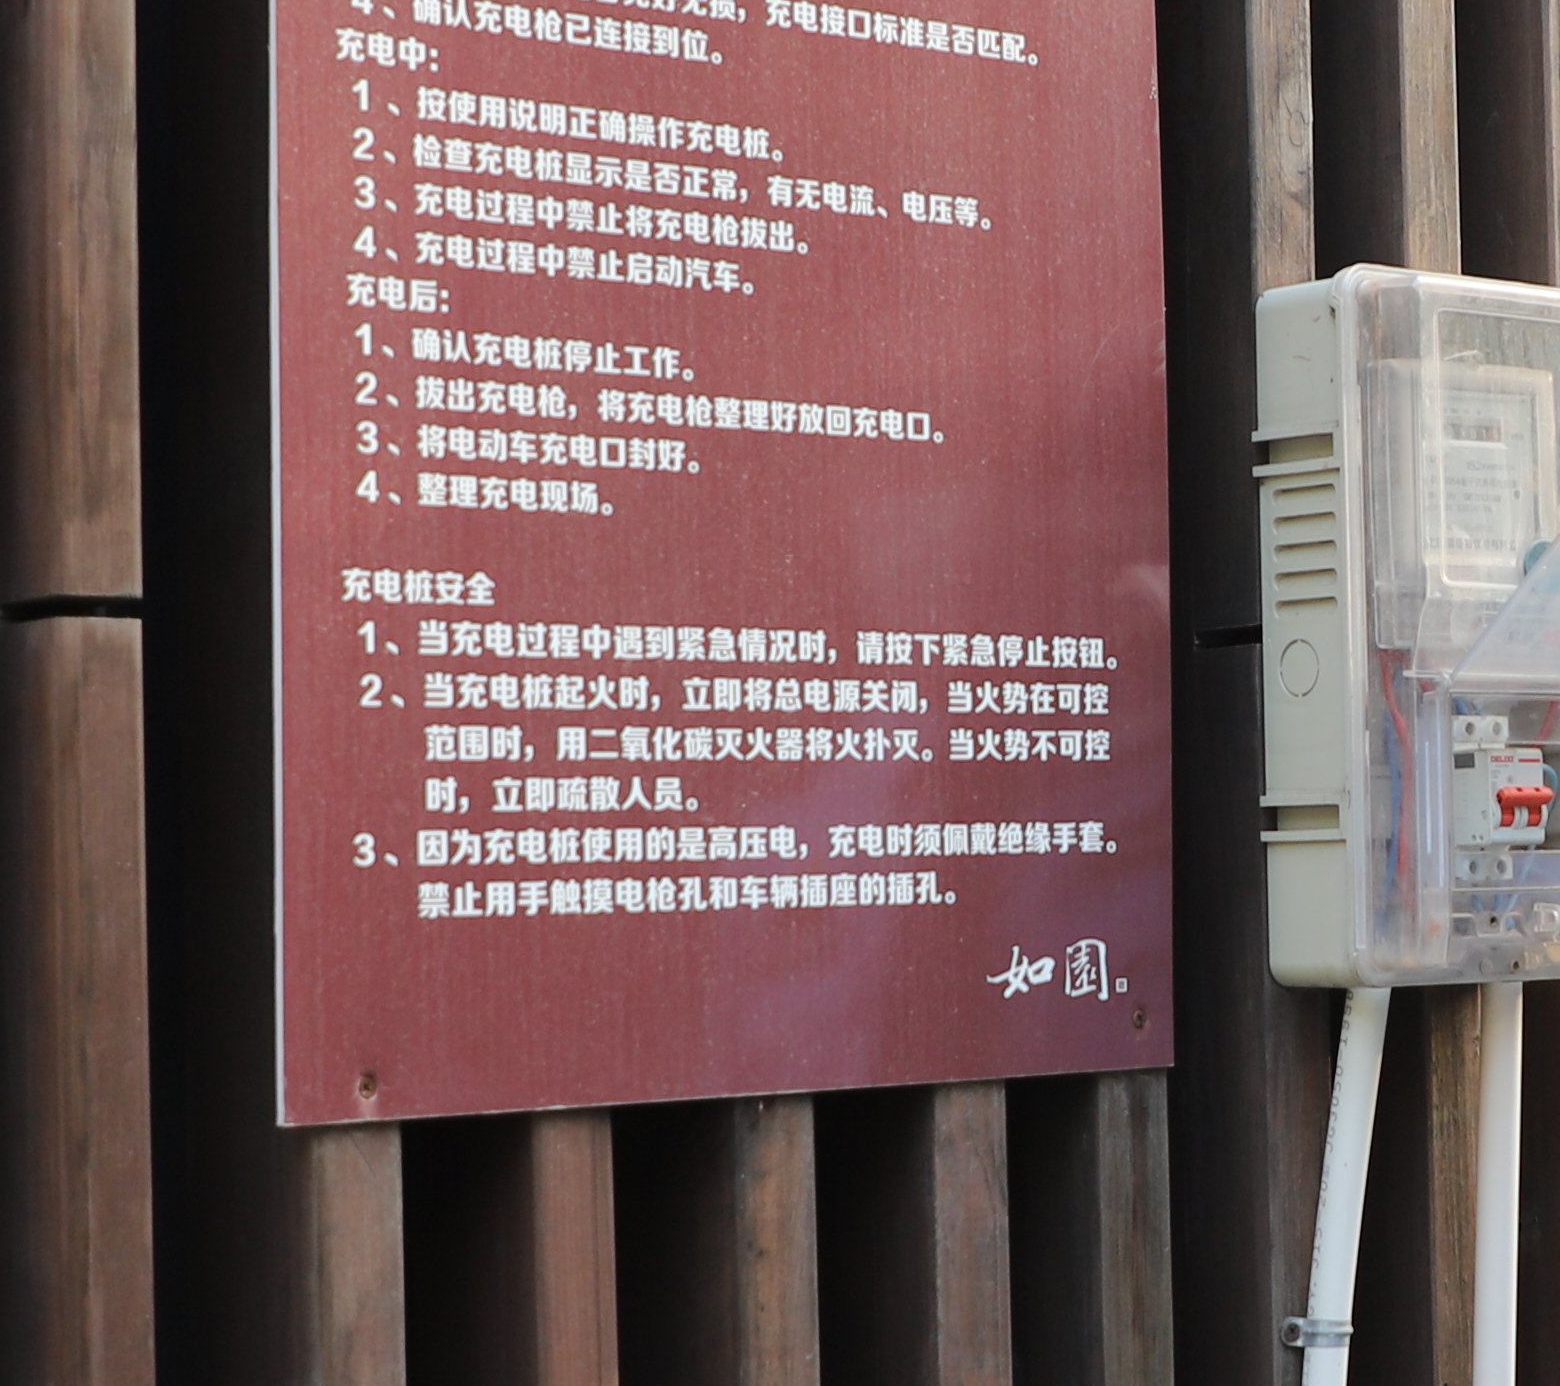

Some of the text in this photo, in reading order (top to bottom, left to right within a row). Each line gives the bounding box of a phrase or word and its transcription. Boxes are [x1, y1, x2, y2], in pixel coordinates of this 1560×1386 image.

[336, 27, 440, 71] 充电中：
[346, 273, 451, 314] 充电后：
[355, 470, 615, 516] 4、整理充电现场。
[340, 567, 498, 606] 充电桩安全
[424, 776, 701, 813] 时，立即疏散人员。
[417, 871, 957, 919] 禁止用手触摸电枪孔和车辆插座的插孔。
